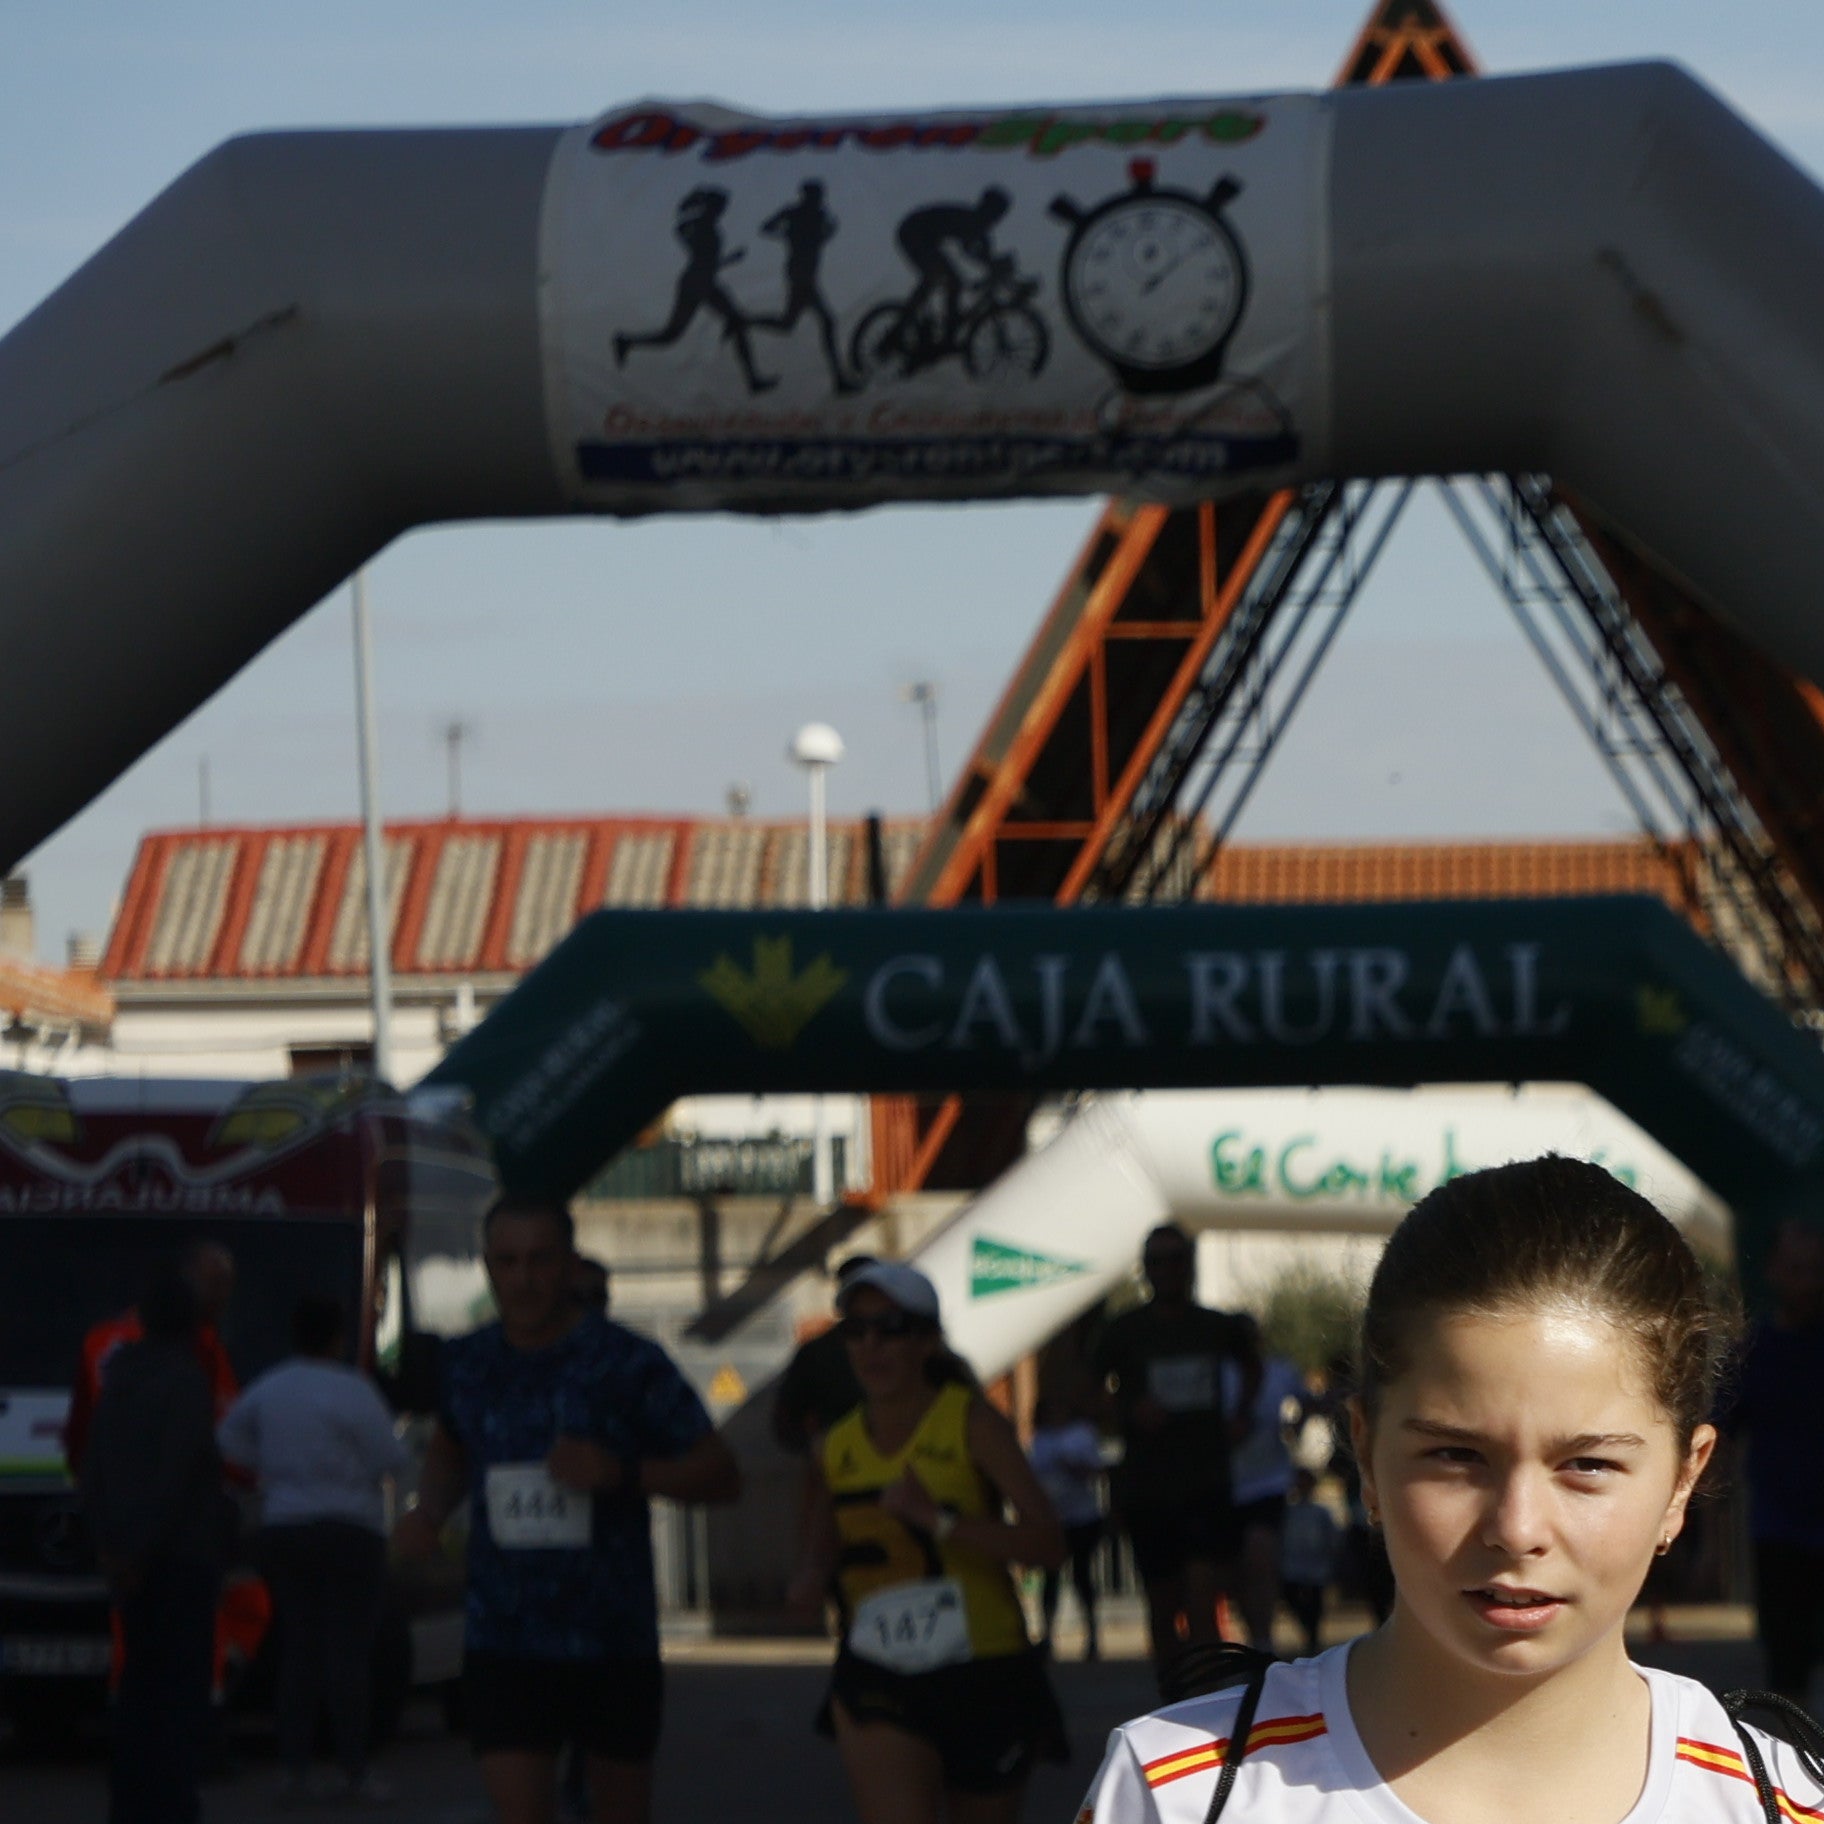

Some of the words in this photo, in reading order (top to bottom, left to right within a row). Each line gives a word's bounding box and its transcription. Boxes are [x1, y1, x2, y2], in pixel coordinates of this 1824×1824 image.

[865, 953, 1183, 1068] CAJA
[1197, 944, 1570, 1045] RURAL
[1212, 1131, 1268, 1196] El
